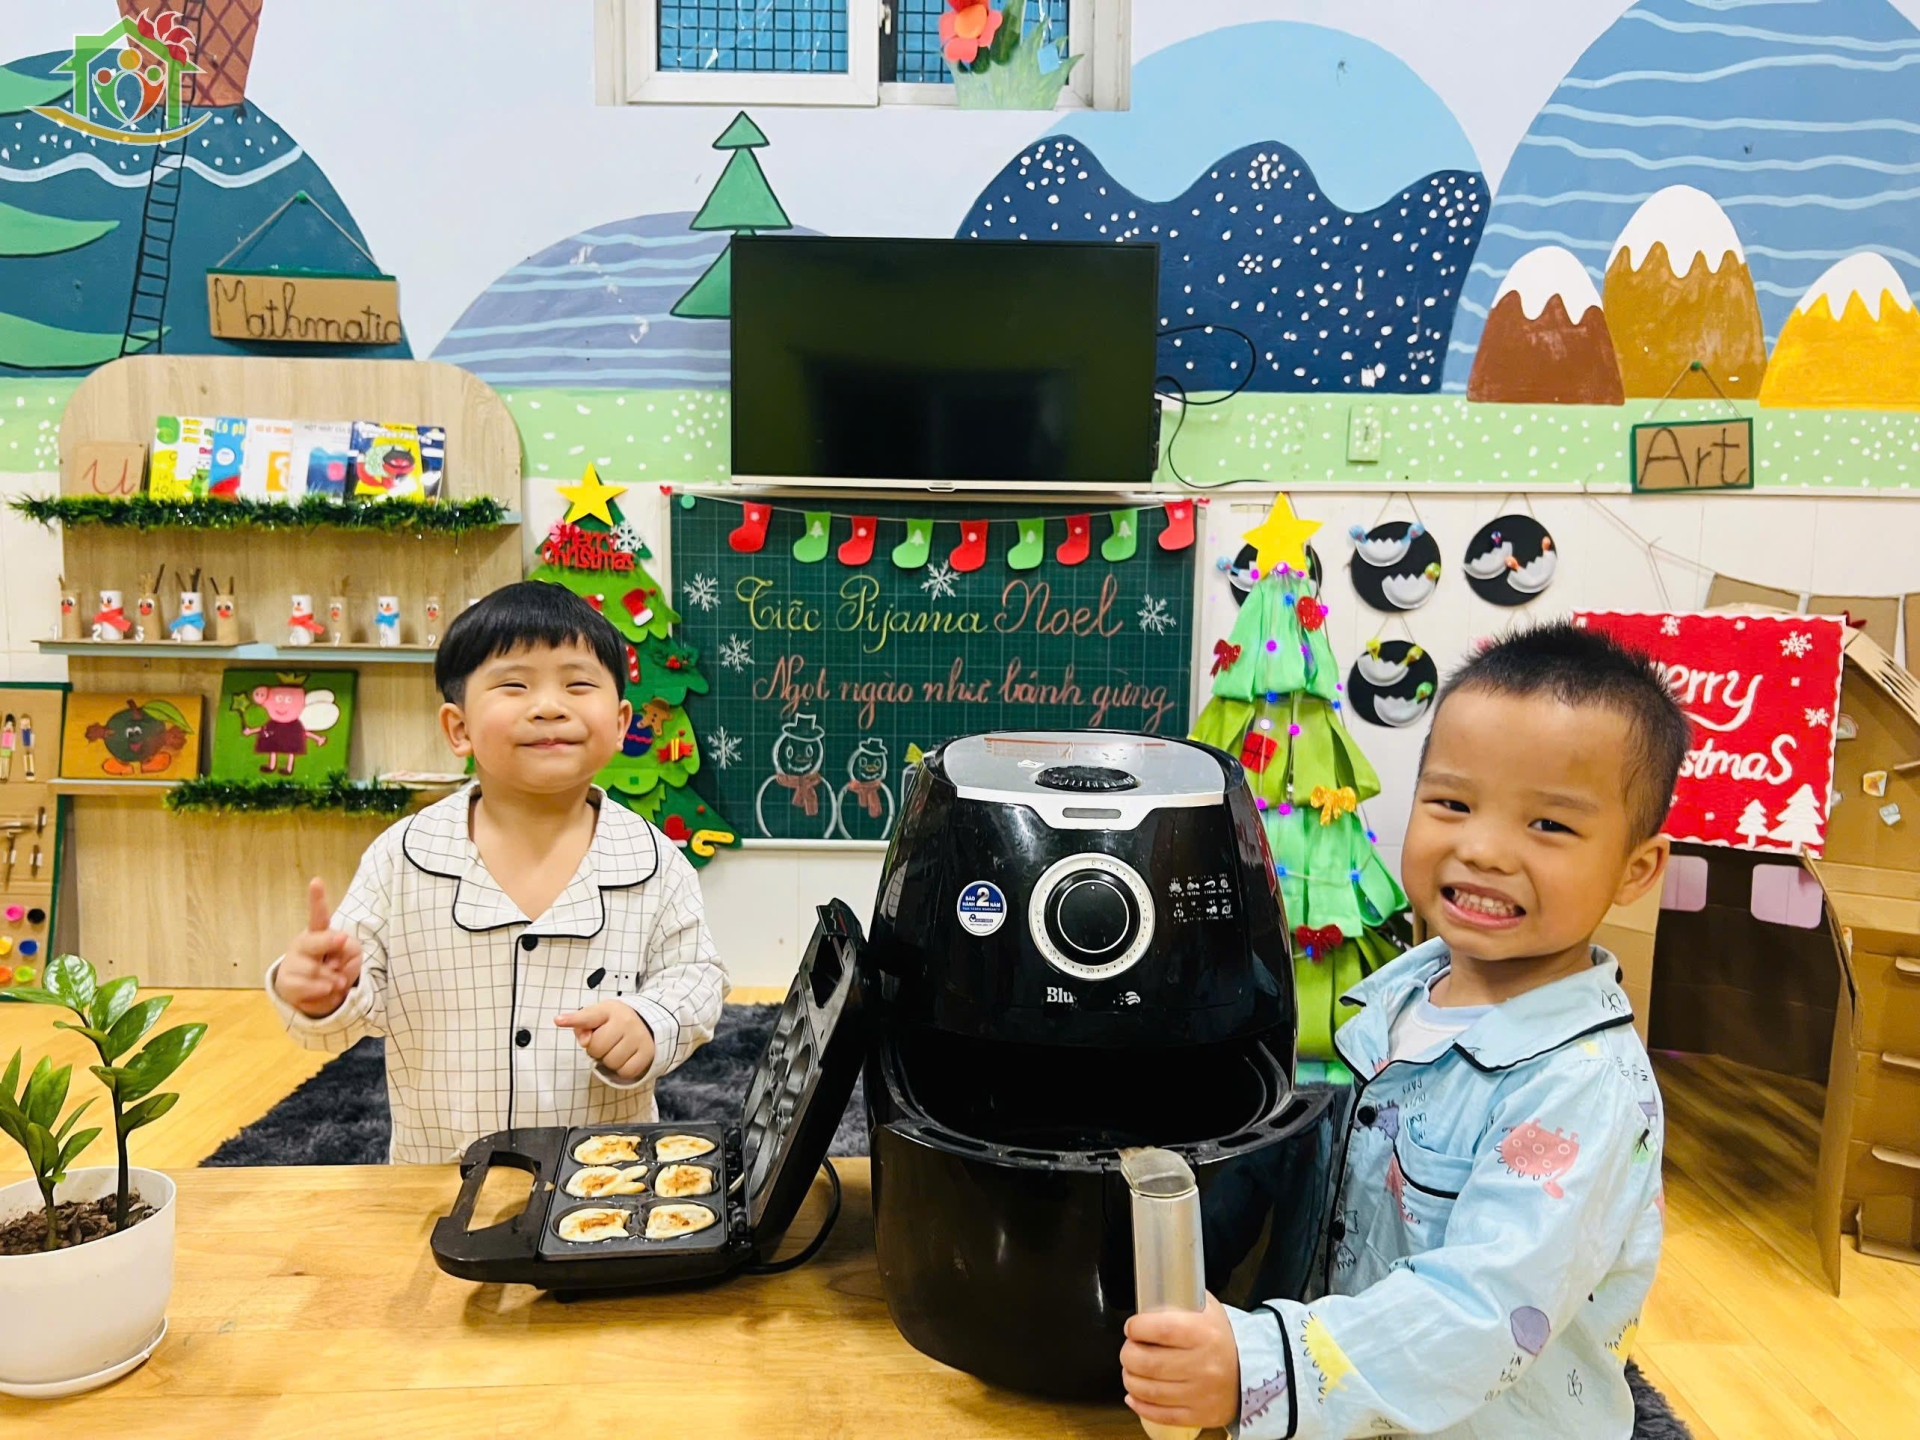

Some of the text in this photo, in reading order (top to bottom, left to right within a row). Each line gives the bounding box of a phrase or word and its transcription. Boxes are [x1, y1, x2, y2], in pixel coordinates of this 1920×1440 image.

[1638, 427, 1746, 487] Art
[557, 524, 618, 556] Merry
[542, 541, 635, 572] Christmas
[836, 574, 988, 653] Pijama
[994, 573, 1124, 638] Noel
[91, 624, 102, 642] 2
[135, 625, 145, 642] 3
[427, 634, 437, 647] 9
[753, 654, 830, 719] Ngọt
[839, 670, 914, 730] ngào
[998, 656, 1087, 706] bánh
[1678, 733, 1798, 786] stmaS
[976, 887, 989, 907] 2
